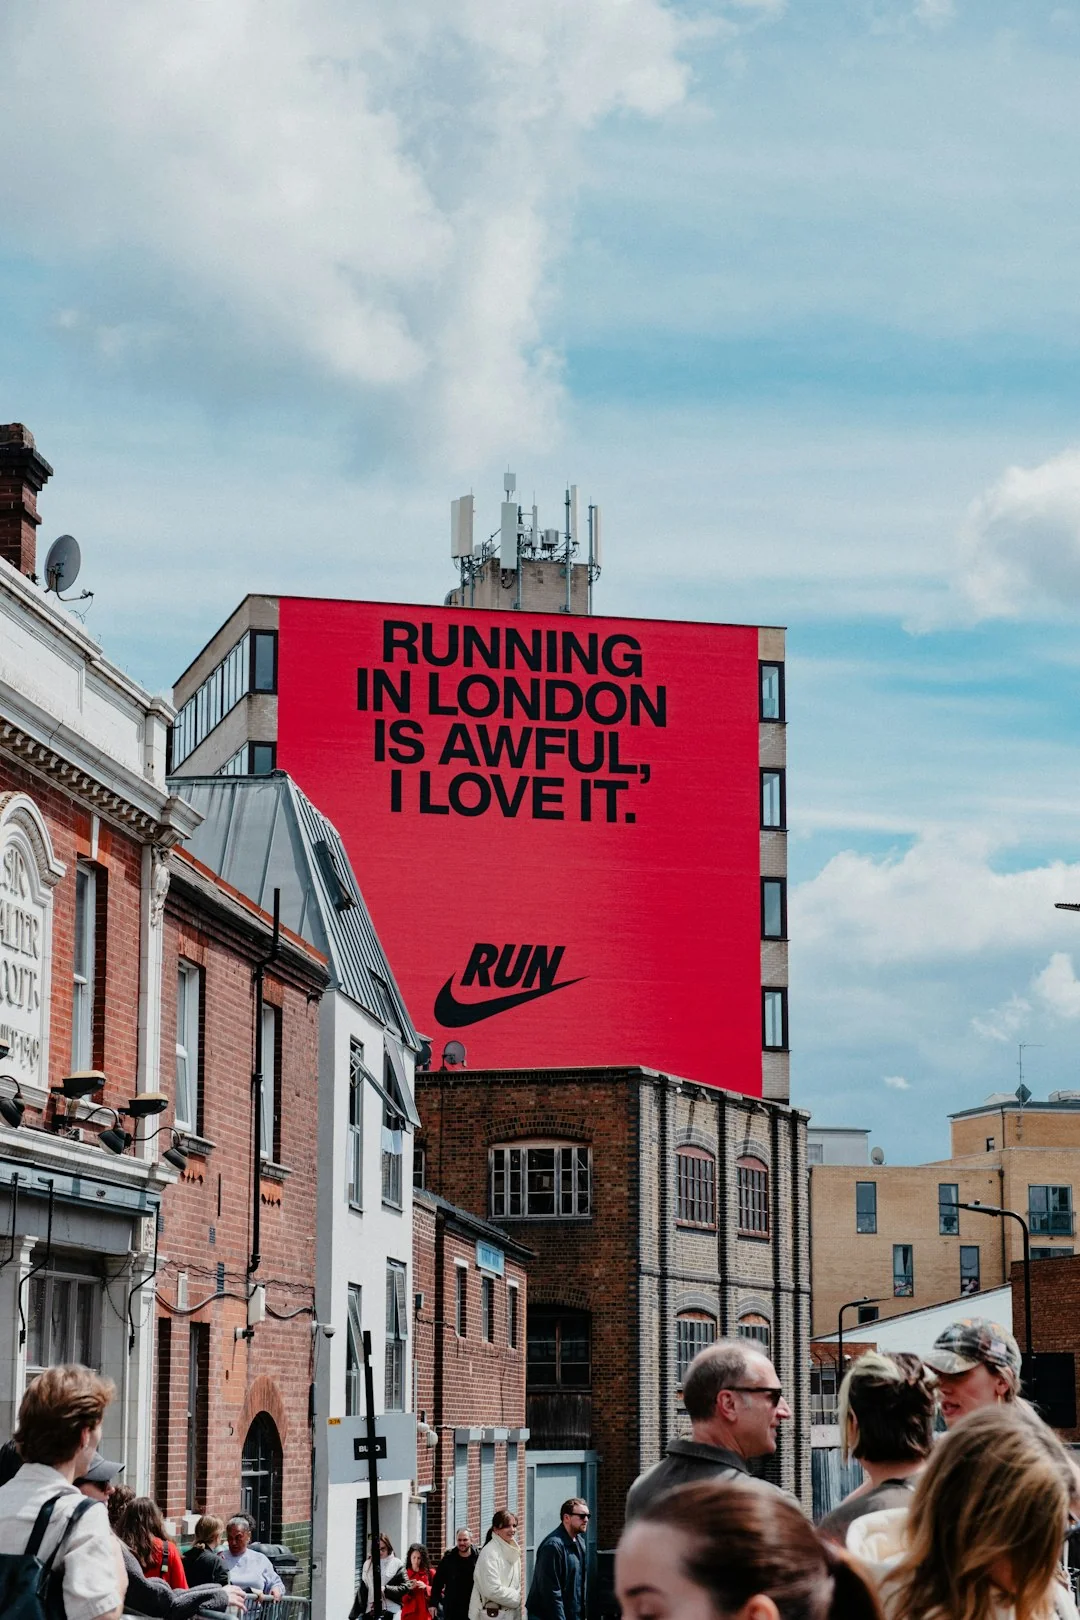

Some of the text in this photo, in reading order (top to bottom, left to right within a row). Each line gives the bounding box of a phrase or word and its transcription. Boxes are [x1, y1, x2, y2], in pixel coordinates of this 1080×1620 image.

[382, 620, 643, 678] RUNNING
[357, 668, 667, 728] IN LONDON
[374, 719, 651, 784] IS AWFUL,
[391, 769, 636, 824] I LOVE IT.
[459, 943, 566, 988] RUN
